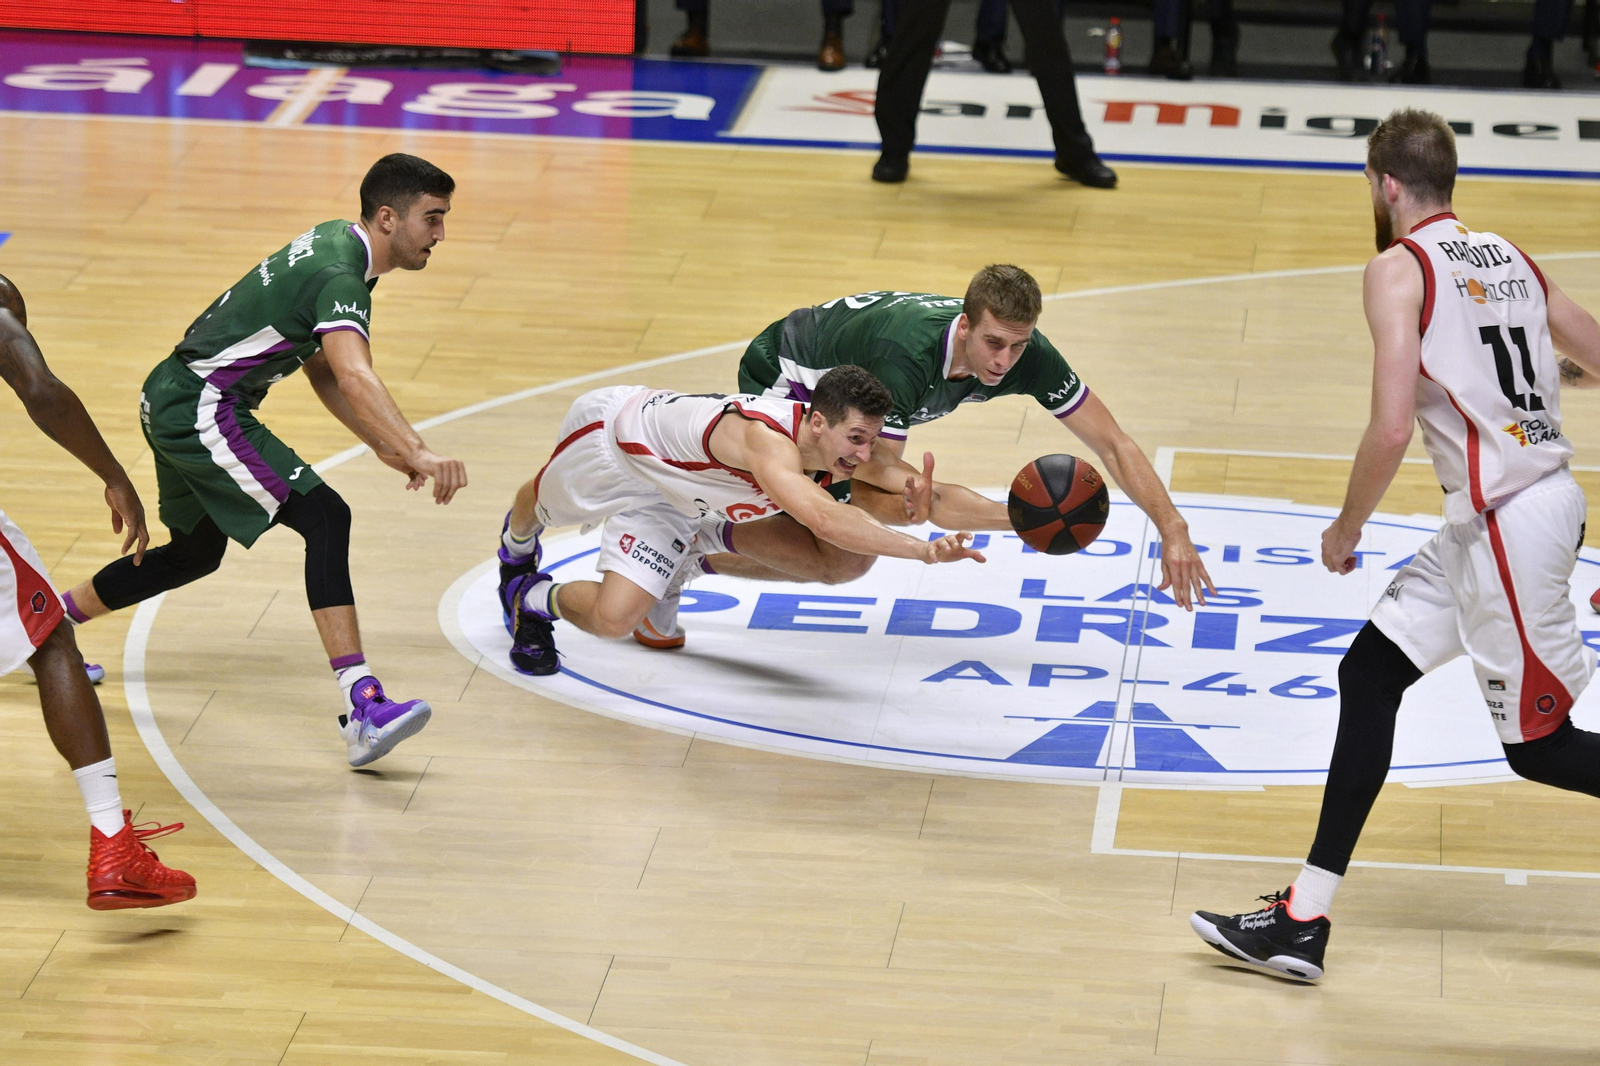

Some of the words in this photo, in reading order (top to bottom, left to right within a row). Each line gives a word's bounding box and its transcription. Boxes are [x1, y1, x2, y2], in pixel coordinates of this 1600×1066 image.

[1437, 241, 1511, 268] RADOVIC
[1478, 325, 1546, 411] 11
[632, 549, 671, 578] DEPORTE
[637, 541, 675, 569] Zaragoza
[1019, 578, 1263, 608] LAS
[920, 660, 1338, 699] AP-46
